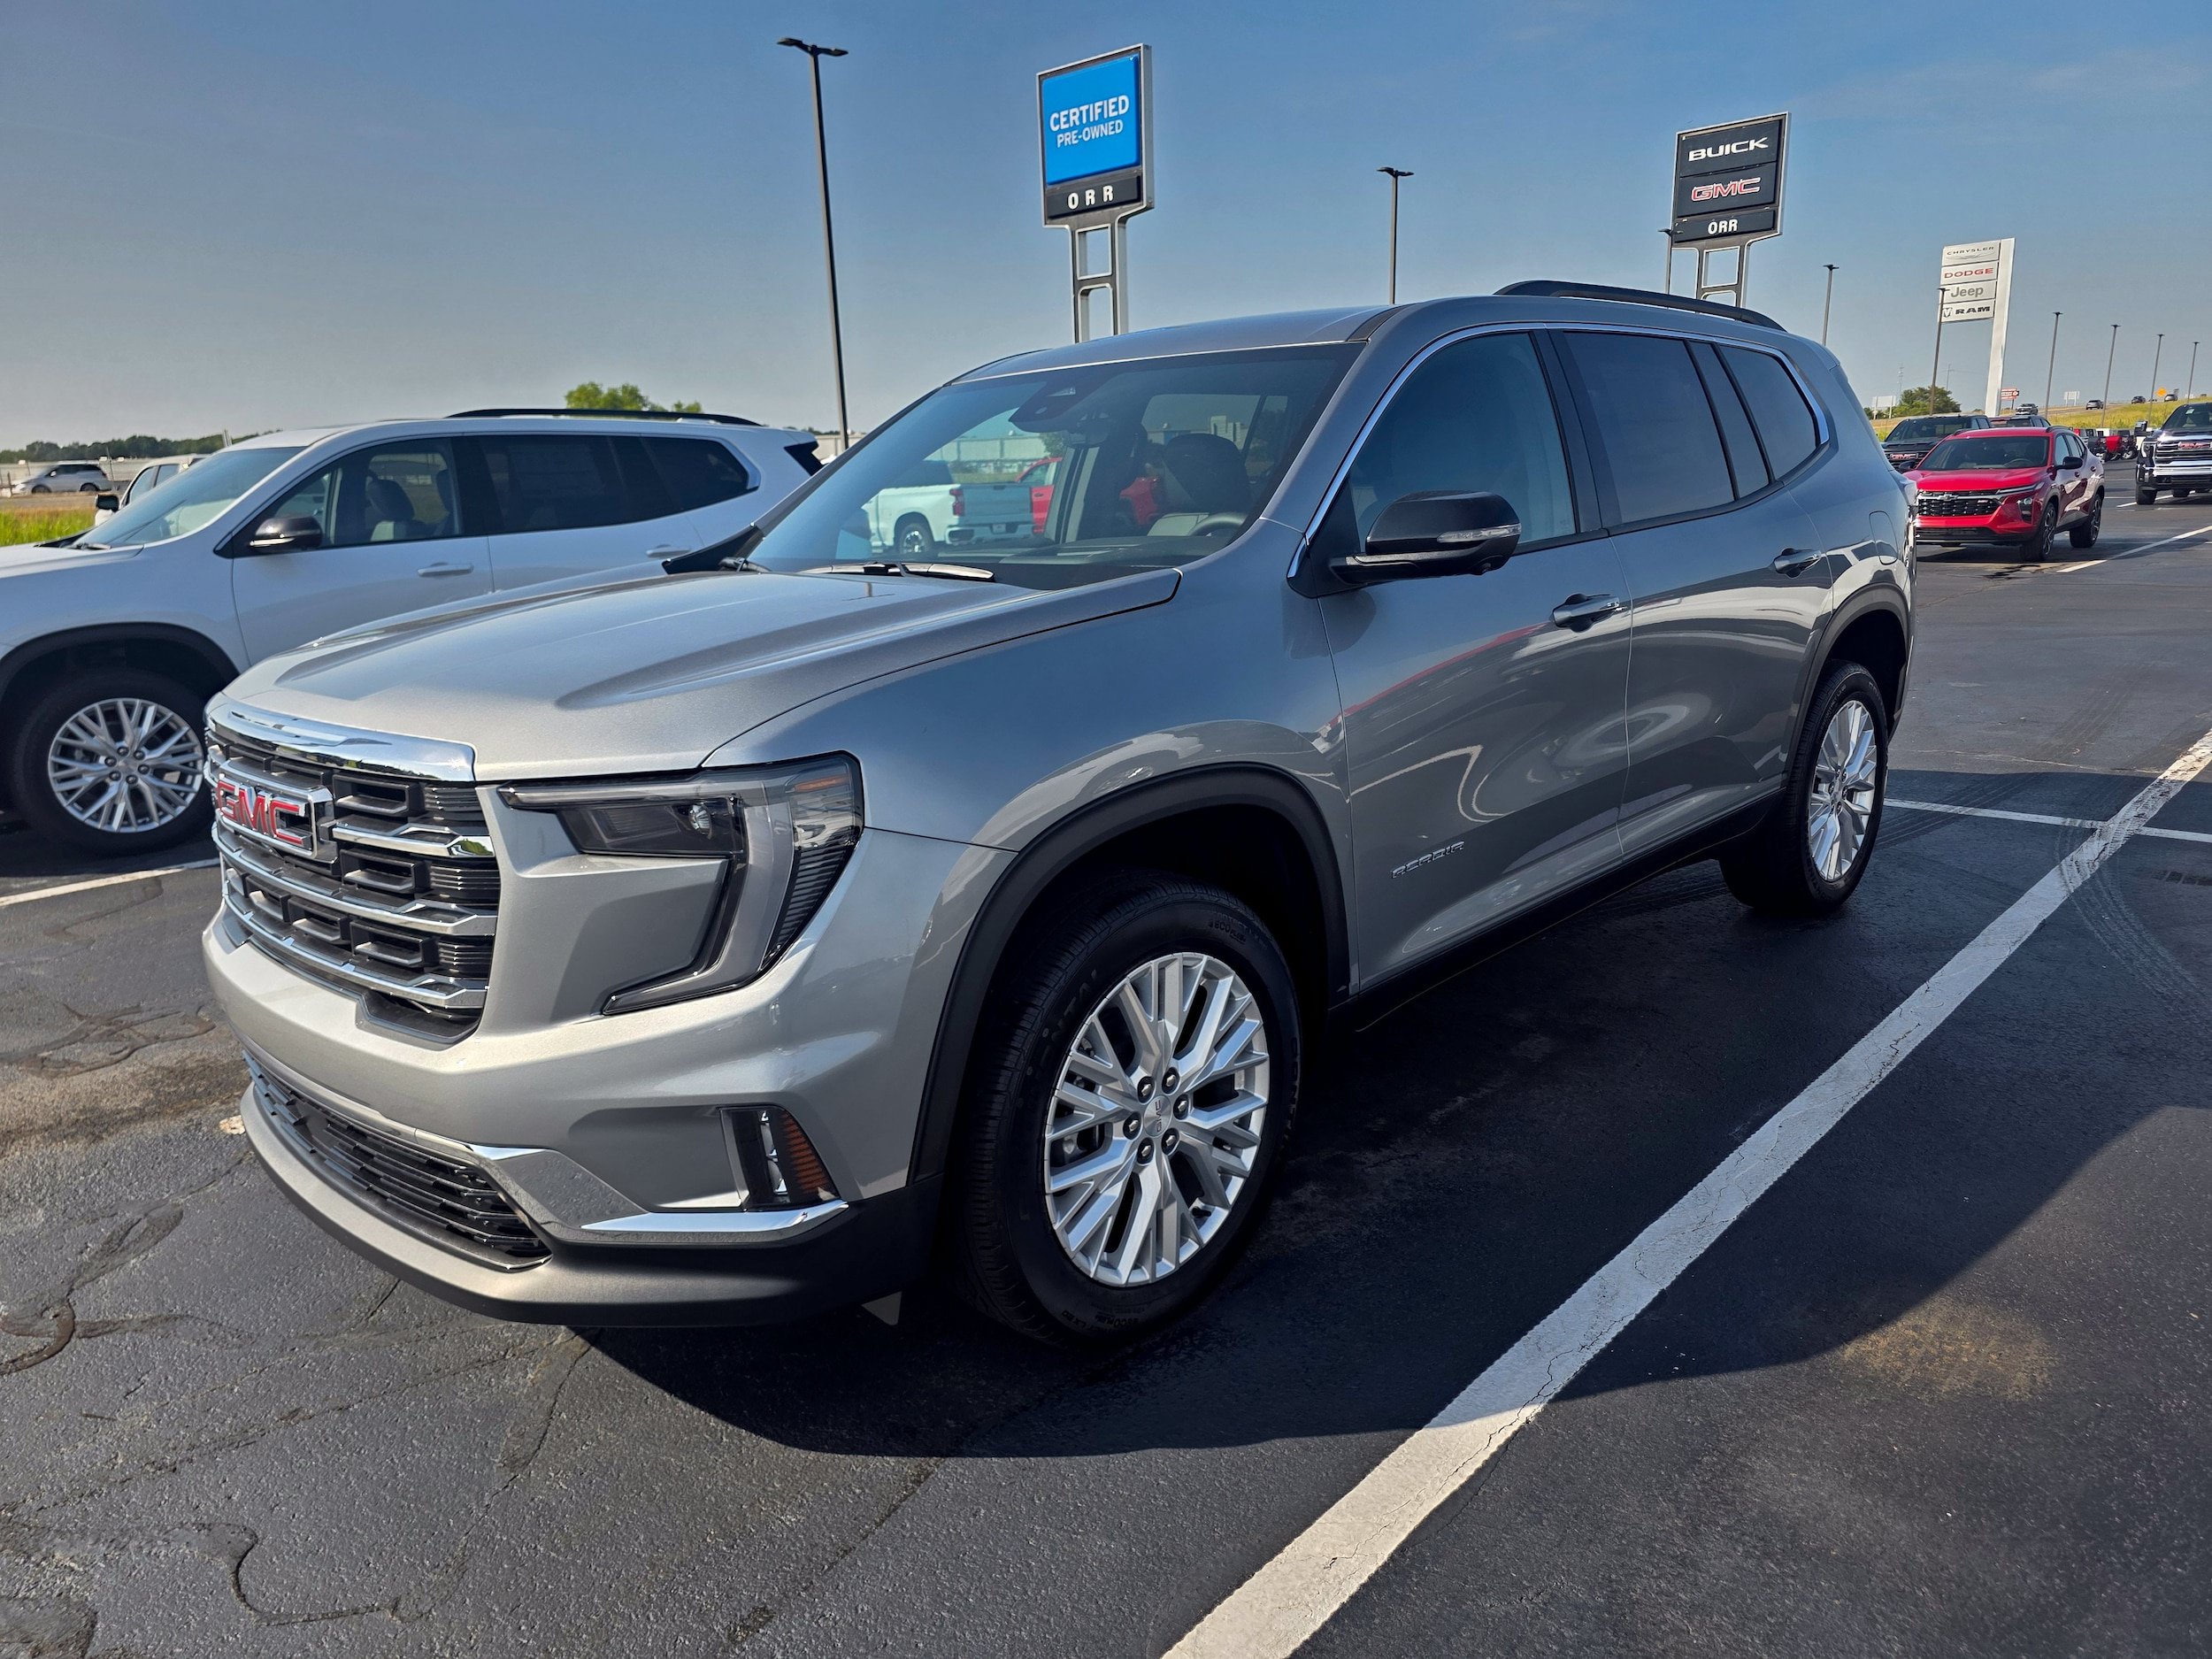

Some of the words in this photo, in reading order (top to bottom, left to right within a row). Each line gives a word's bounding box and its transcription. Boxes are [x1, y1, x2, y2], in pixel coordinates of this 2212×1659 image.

[1049, 95, 1130, 132] CERTIFIED
[1056, 119, 1124, 148] PRE-OWNED
[1688, 136, 1769, 162] BUICK
[1067, 185, 1114, 210] ORR
[1691, 177, 1762, 202] GMC
[1708, 219, 1738, 235] ORR
[1947, 246, 1994, 256] CHRYSLER
[1944, 267, 1994, 279] DODGE
[1950, 287, 1984, 298] Jeep
[1955, 306, 1991, 315] RAM
[215, 778, 307, 848] GMC
